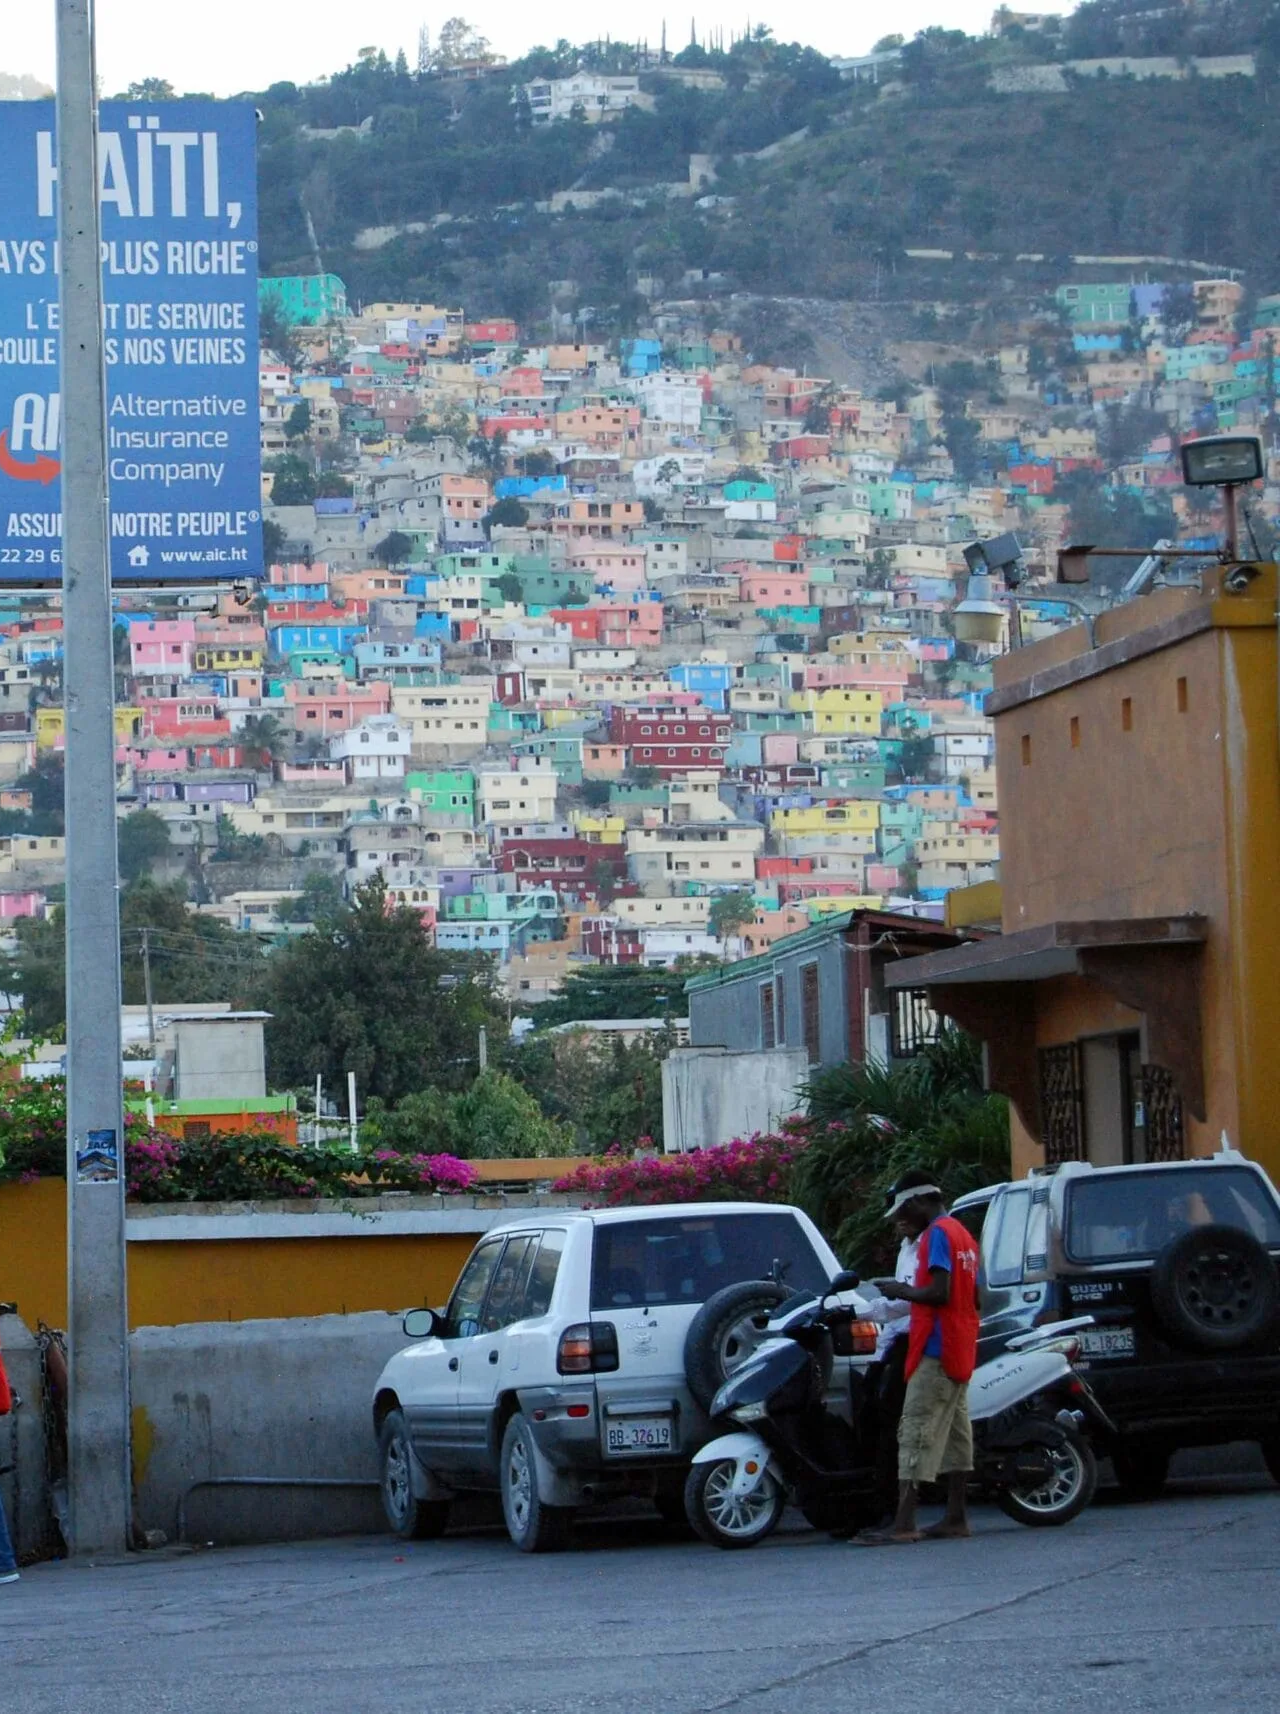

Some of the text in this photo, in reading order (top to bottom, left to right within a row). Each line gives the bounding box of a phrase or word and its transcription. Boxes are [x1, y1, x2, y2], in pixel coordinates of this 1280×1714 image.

[126, 303, 152, 330] DE
[158, 303, 245, 330] SERVICE
[125, 338, 166, 365] NOS
[170, 338, 245, 365] VEINES
[110, 394, 247, 416] Alternative
[110, 426, 228, 449] Insurance
[110, 458, 224, 487] Company
[111, 512, 171, 538] NOTRE
[0, 548, 20, 563] 22
[25, 548, 45, 563] 29
[161, 548, 248, 562] www.aic.ht
